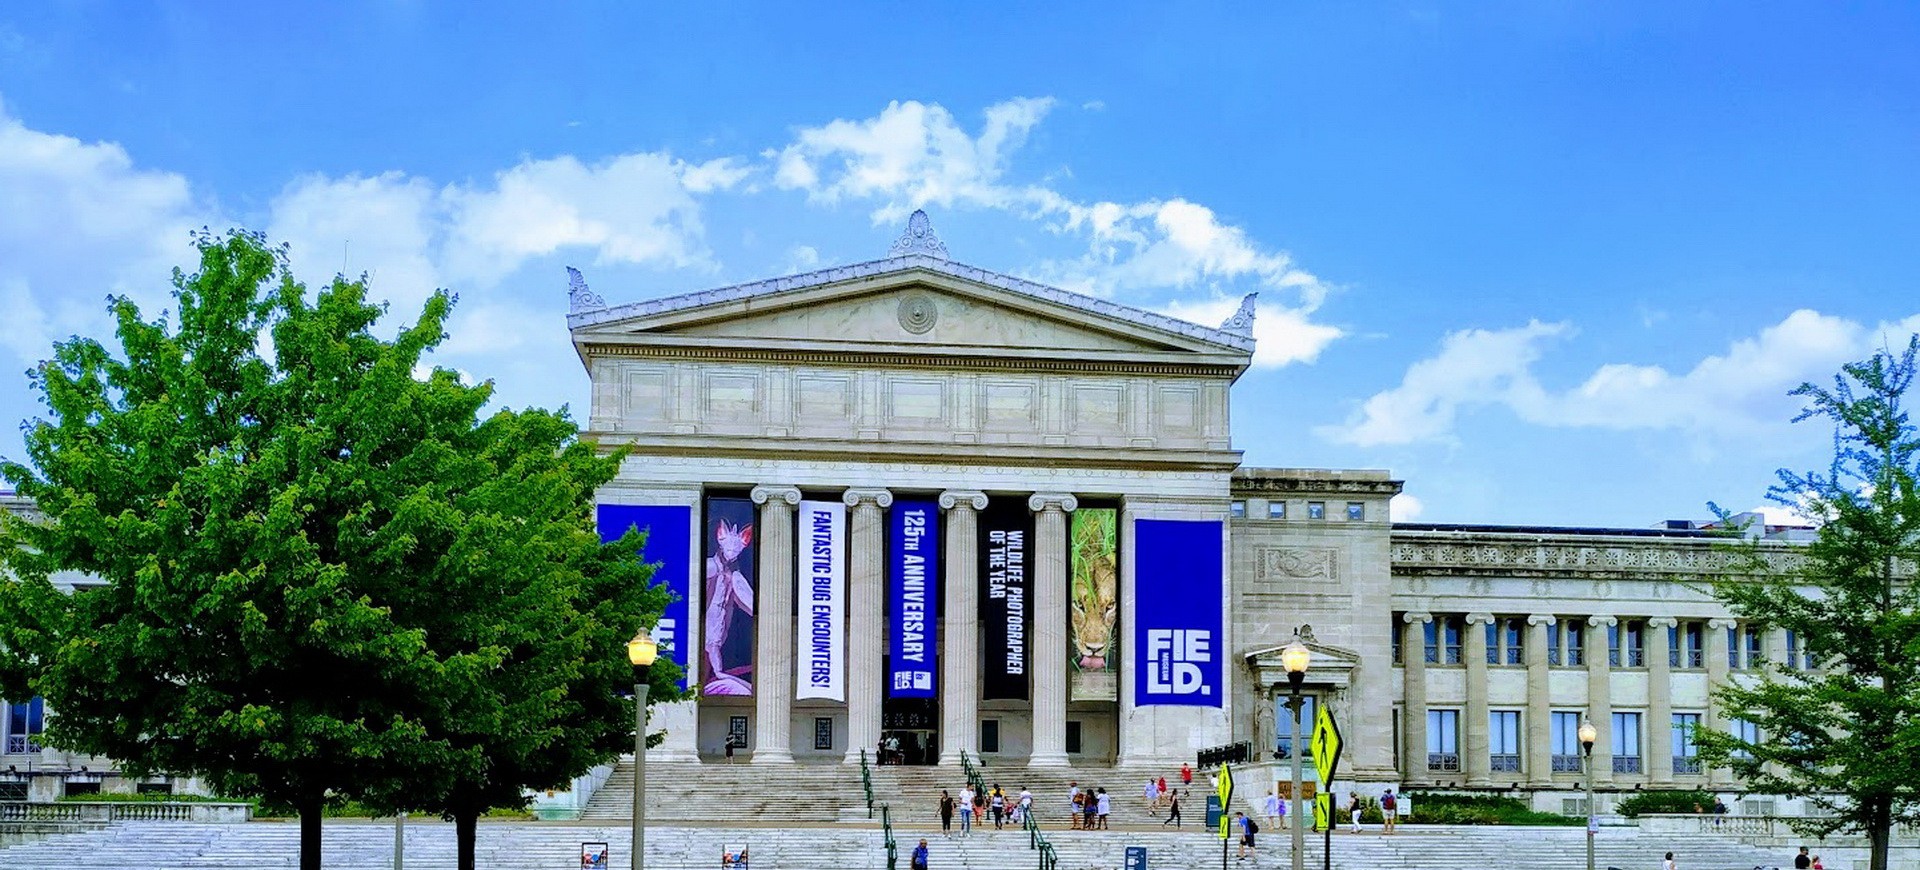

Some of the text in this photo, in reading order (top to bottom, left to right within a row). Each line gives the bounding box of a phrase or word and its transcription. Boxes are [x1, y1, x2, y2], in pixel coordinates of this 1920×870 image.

[903, 509, 925, 551] 125TH
[989, 530, 1006, 599] OF THE YEAR
[811, 510, 832, 688] FANTASTIC BUG ENCOUNTERS!
[903, 554, 925, 663] ANNIVERSARY
[1006, 530, 1024, 675] WILDLIFE PHOTOGRAPHER
